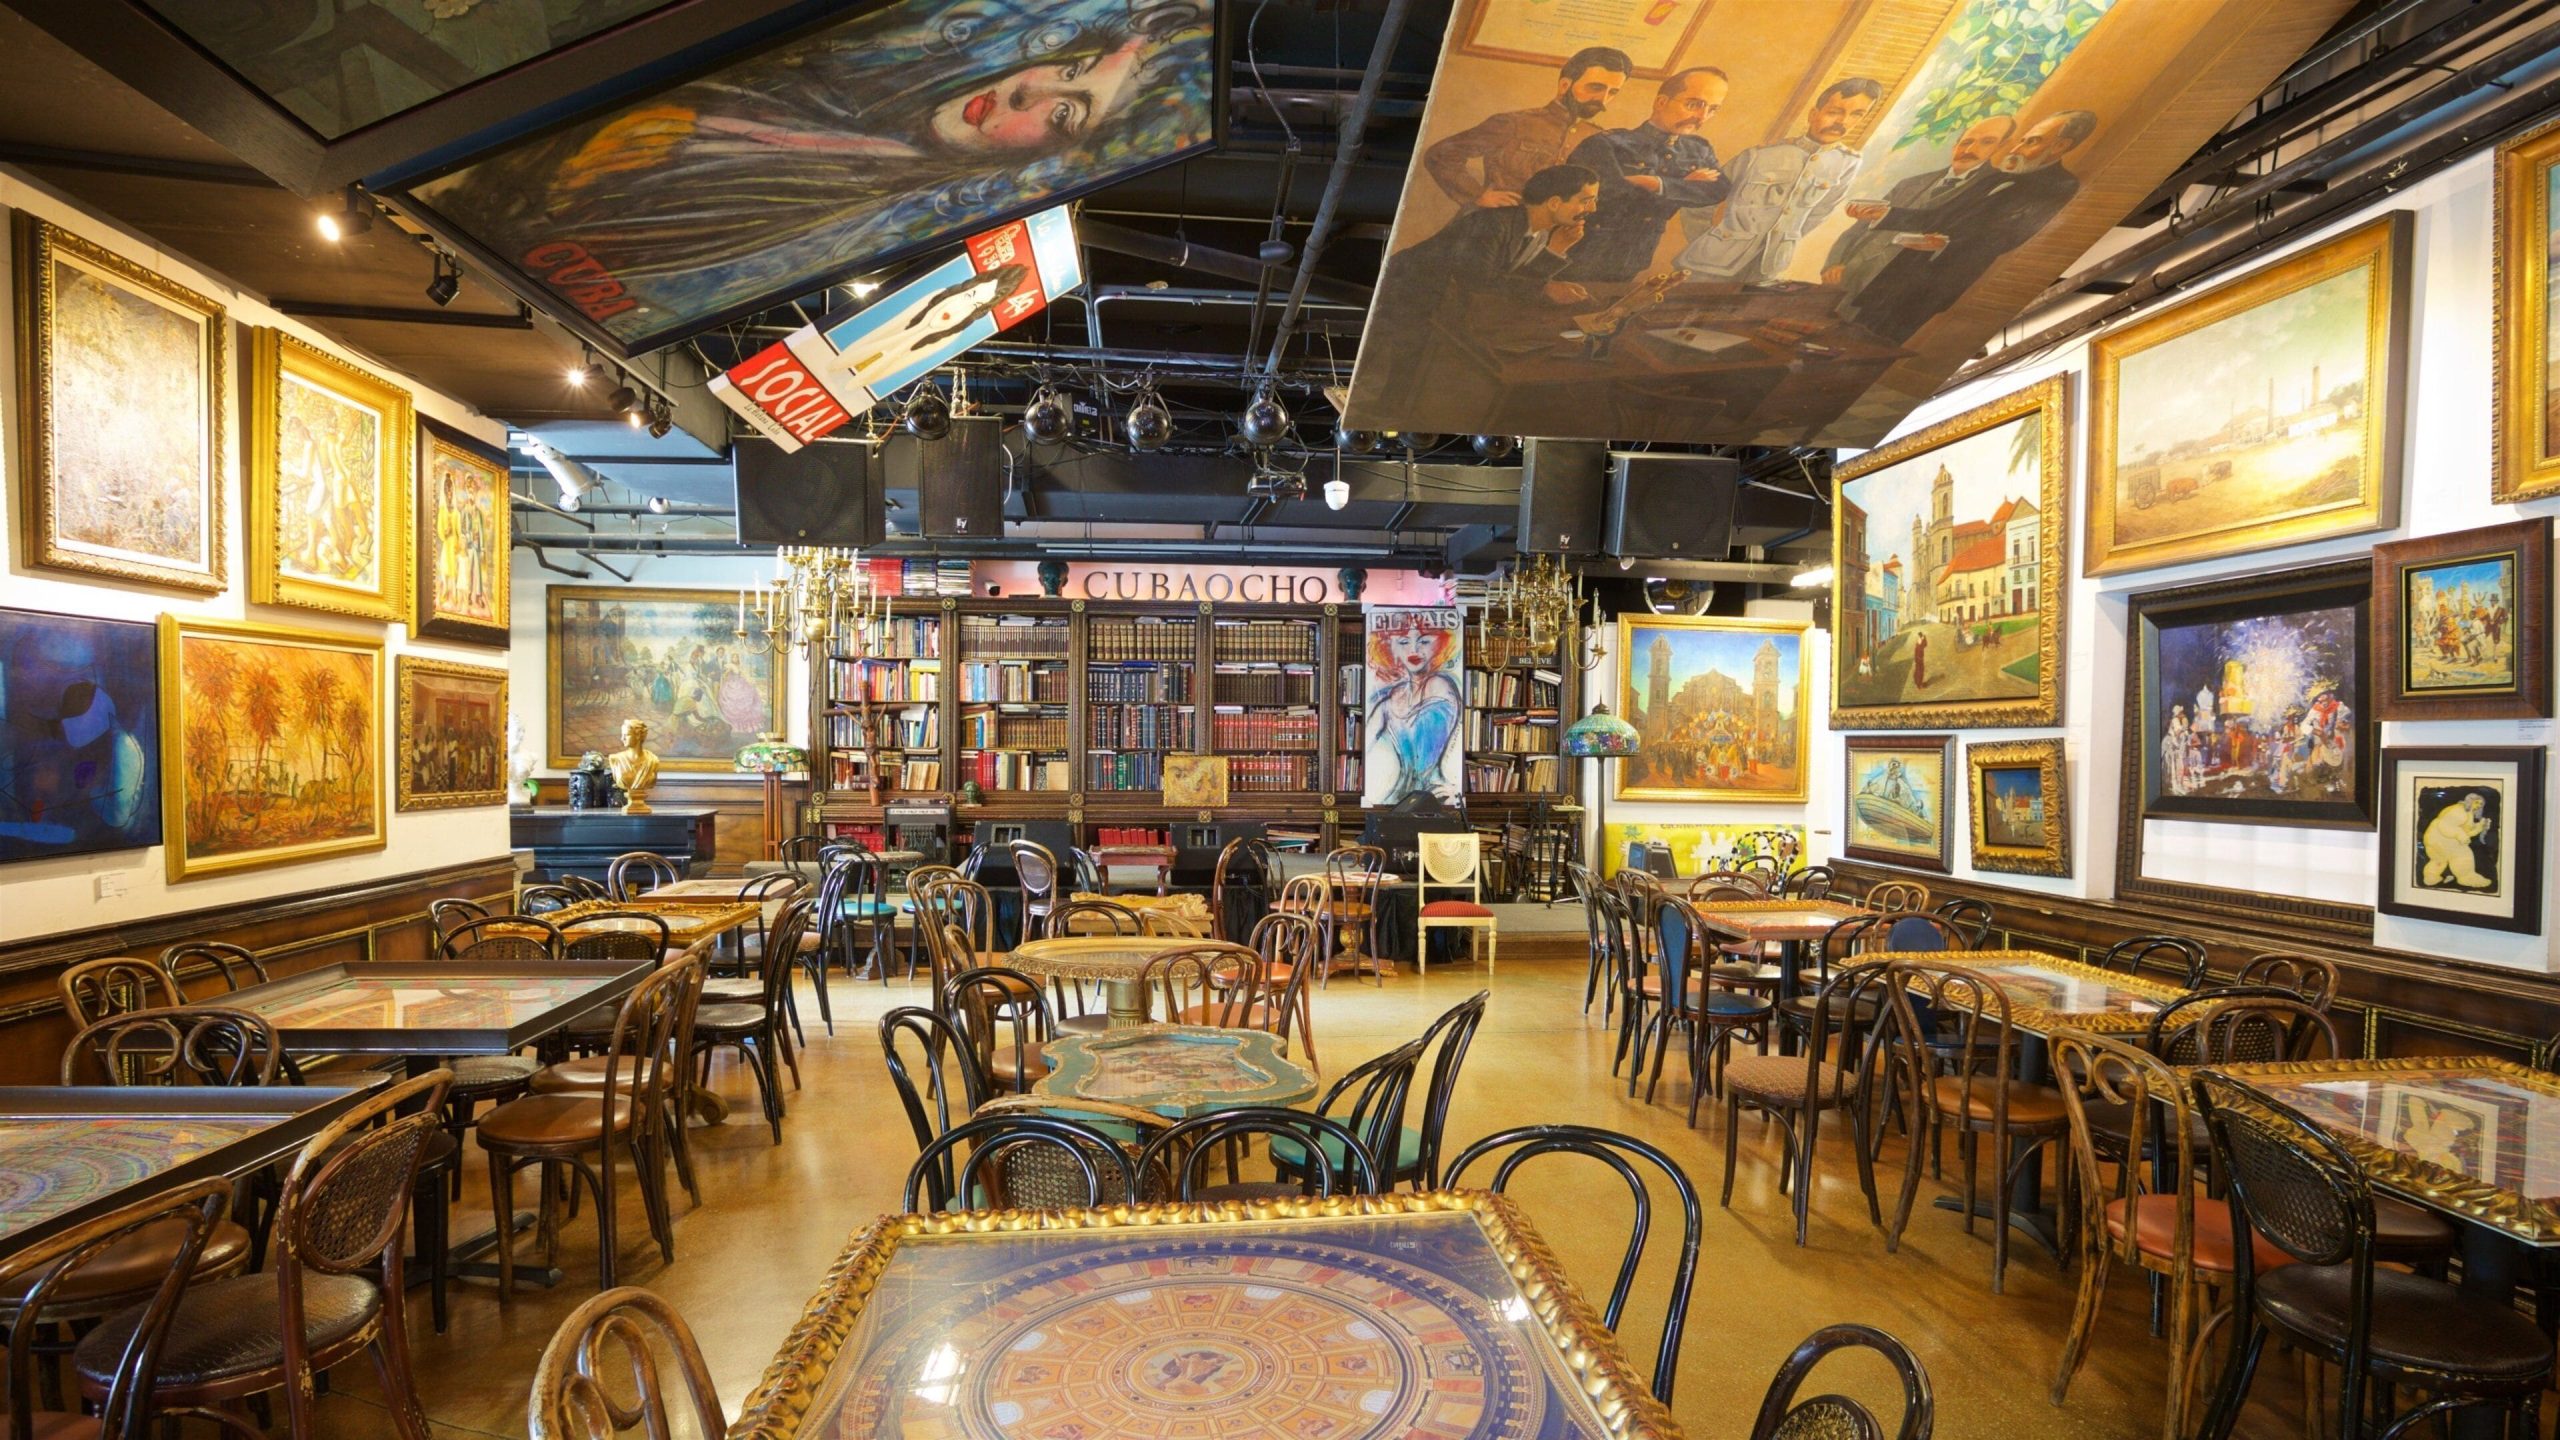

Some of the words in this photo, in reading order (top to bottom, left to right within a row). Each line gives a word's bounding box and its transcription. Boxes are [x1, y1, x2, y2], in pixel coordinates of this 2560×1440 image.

[525, 242, 637, 321] CUBA
[740, 357, 844, 441] SOCIAL
[1083, 570, 1328, 603] CUBAOCHO
[1372, 612, 1402, 631] EL
[1518, 657, 1552, 665] BELEVE
